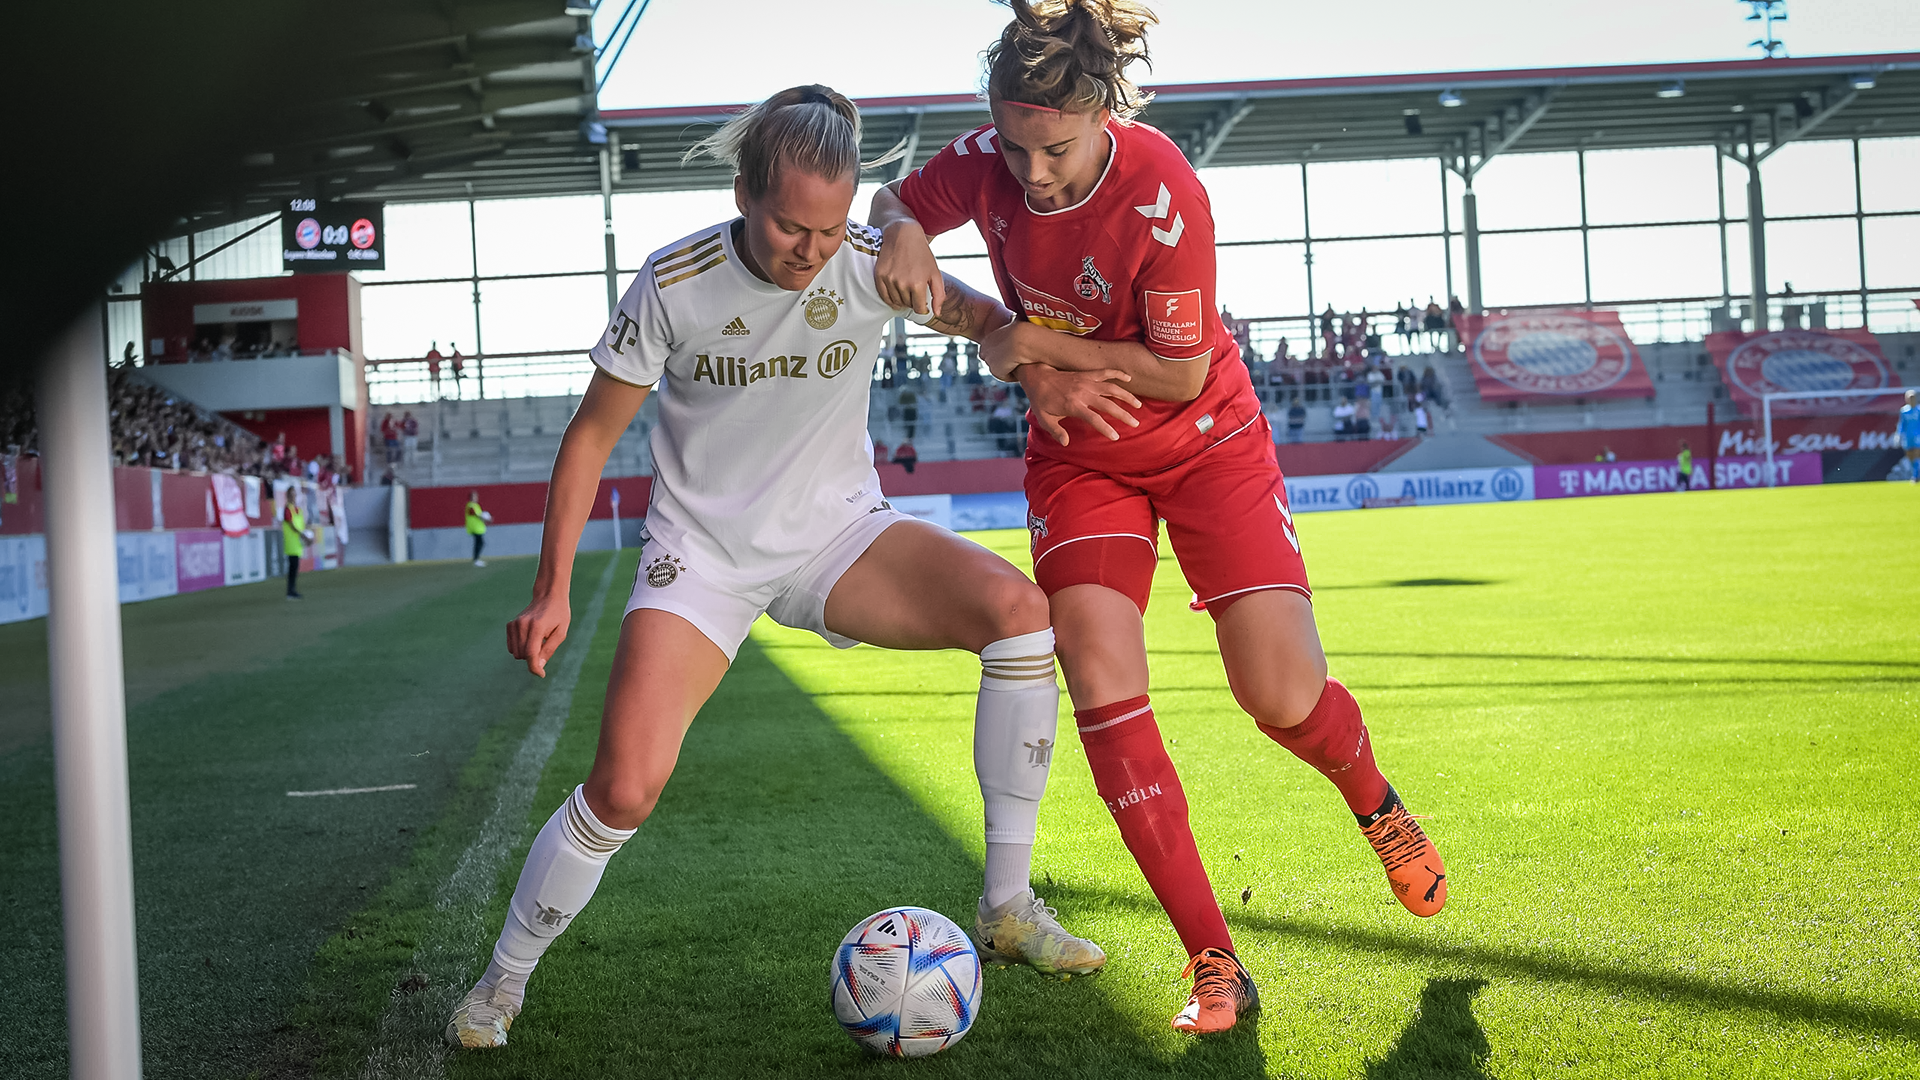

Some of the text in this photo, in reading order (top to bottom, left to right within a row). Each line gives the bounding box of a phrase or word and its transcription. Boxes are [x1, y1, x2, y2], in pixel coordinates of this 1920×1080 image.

[721, 327, 751, 336] adidas
[1152, 318, 1196, 329] FLYERALARM
[1152, 324, 1183, 335] FRAUEN-
[1153, 330, 1197, 341] BUNDESLIGA
[693, 354, 808, 387] Allianz
[1400, 475, 1485, 499] Allianz
[1583, 464, 1709, 493] MAGENA
[1117, 782, 1163, 810] KÖLN
